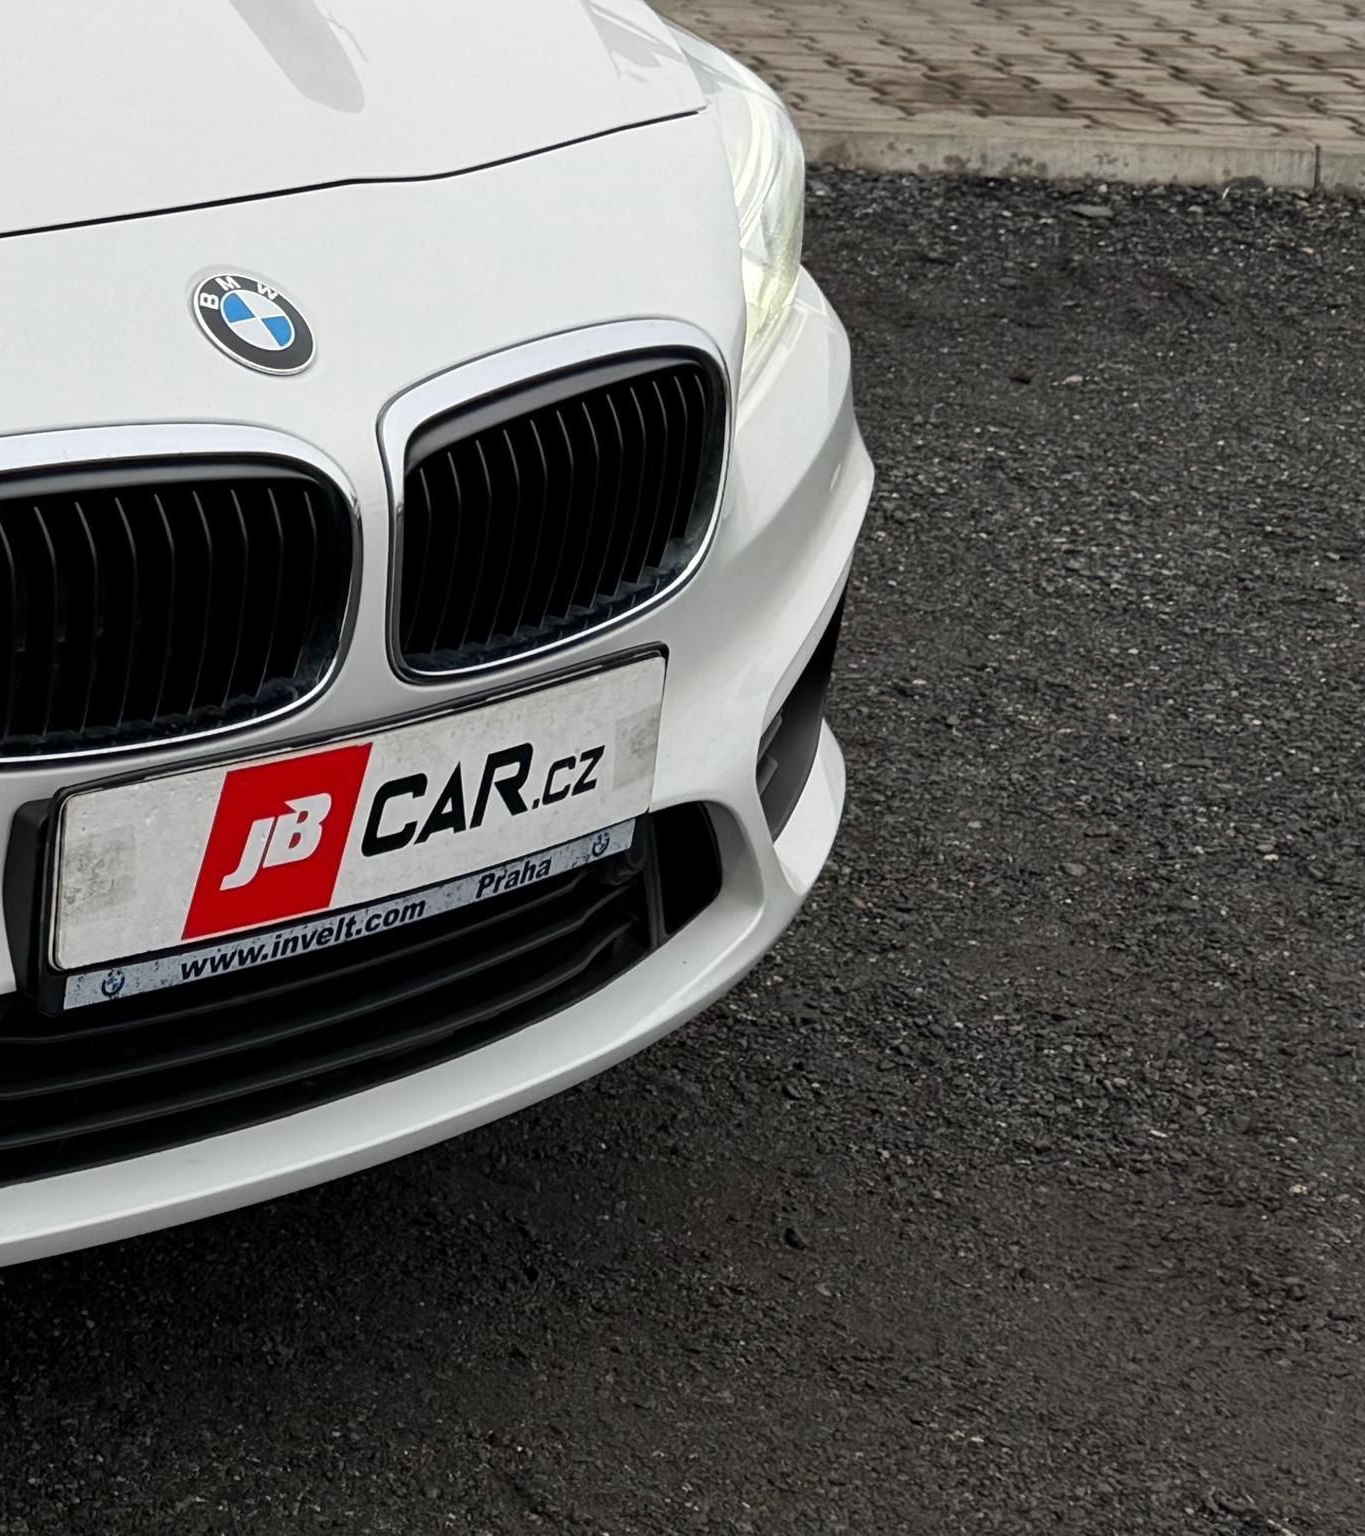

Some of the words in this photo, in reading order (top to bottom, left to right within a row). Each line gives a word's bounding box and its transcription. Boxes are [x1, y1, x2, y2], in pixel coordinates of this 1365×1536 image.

[199, 275, 279, 310] BMW
[219, 792, 332, 892] JB
[180, 898, 426, 981] www.invelt.com
[475, 857, 552, 900] Praha
